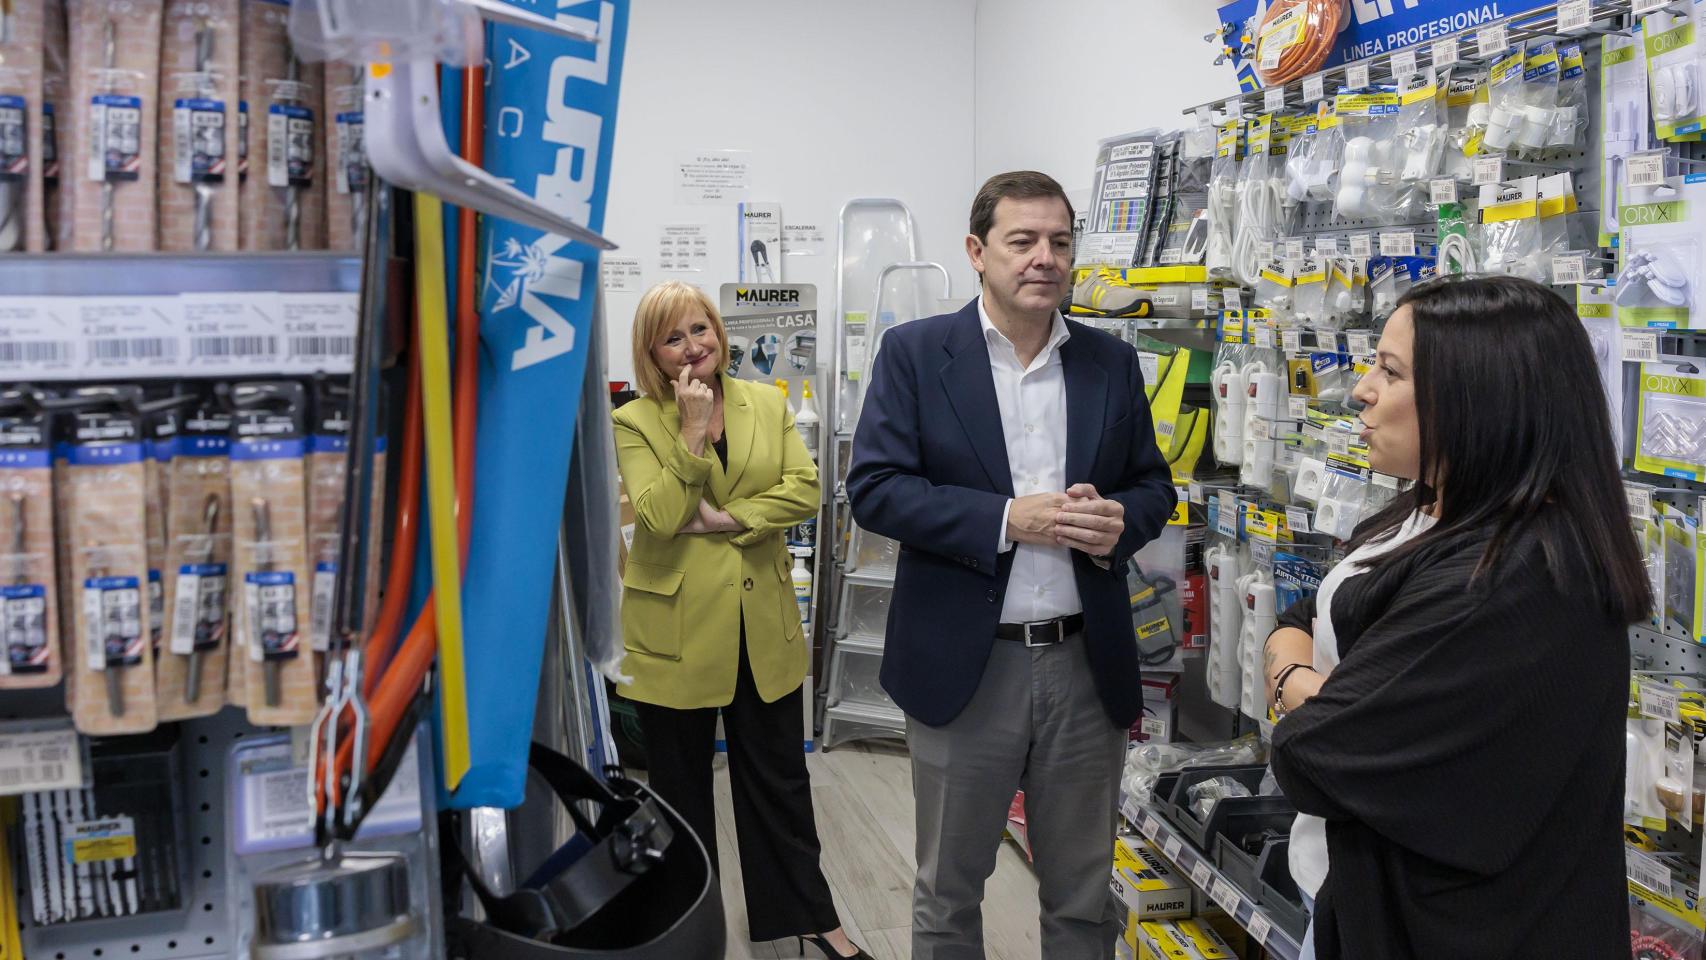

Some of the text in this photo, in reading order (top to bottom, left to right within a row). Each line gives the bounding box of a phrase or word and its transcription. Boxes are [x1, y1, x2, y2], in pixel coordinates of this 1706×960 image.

[1272, 11, 1293, 27] MAURER
[1343, 38, 1384, 63] LINEA
[1387, 2, 1505, 50] PROFESIONAL
[1653, 29, 1688, 52] ORYX
[1604, 51, 1627, 65] ORYX
[1407, 79, 1428, 91] MAURER
[1496, 191, 1523, 203] MAURER
[1624, 203, 1668, 225] ORYX
[1300, 265, 1317, 273] MAURER
[736, 288, 799, 302] MAURER
[776, 314, 815, 328] CASA
[1646, 375, 1689, 394] ORYX
[1274, 568, 1301, 587] JUPITER
[1134, 847, 1169, 876] MAURER
[1147, 901, 1184, 912] MAURER
[1170, 930, 1189, 949] MAURER
